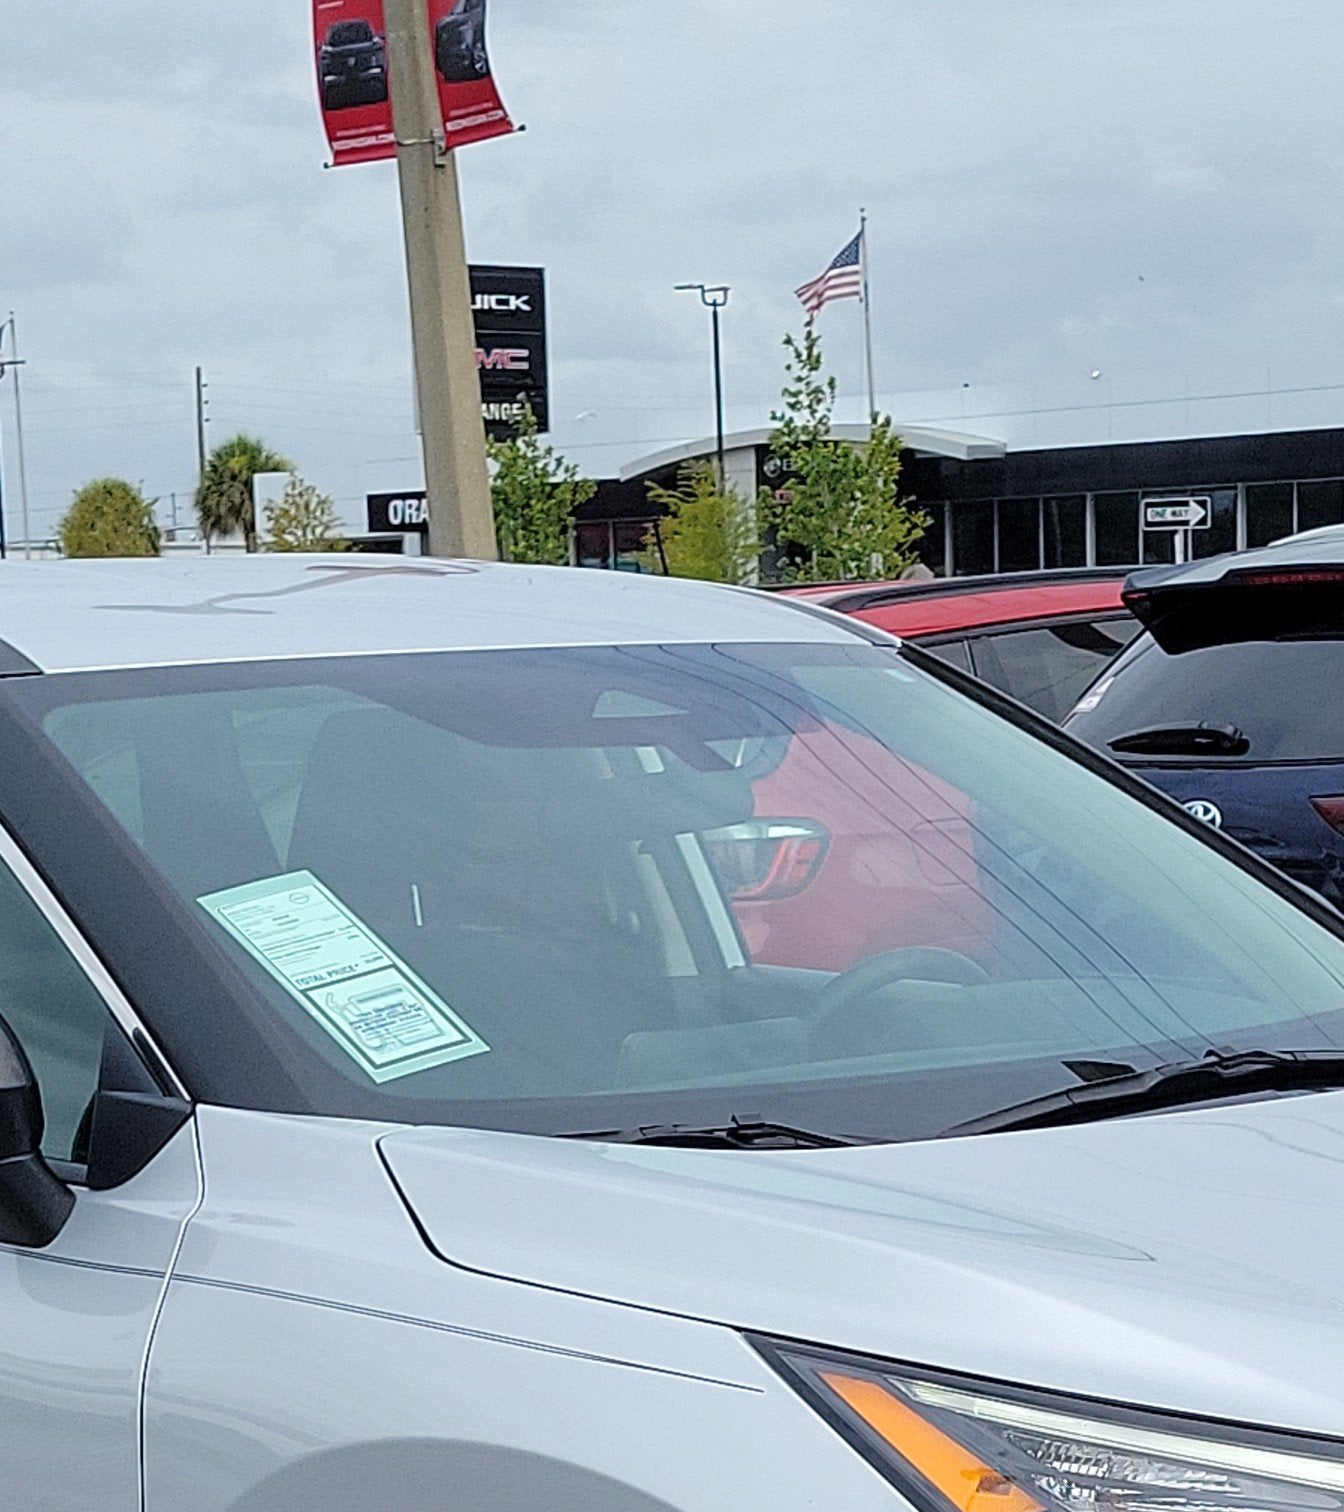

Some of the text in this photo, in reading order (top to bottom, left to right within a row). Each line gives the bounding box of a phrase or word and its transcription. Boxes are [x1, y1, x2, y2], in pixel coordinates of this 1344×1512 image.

[471, 293, 532, 311] UICK
[475, 348, 530, 370] MC
[482, 402, 525, 421] ANGE
[388, 498, 428, 526] ORA
